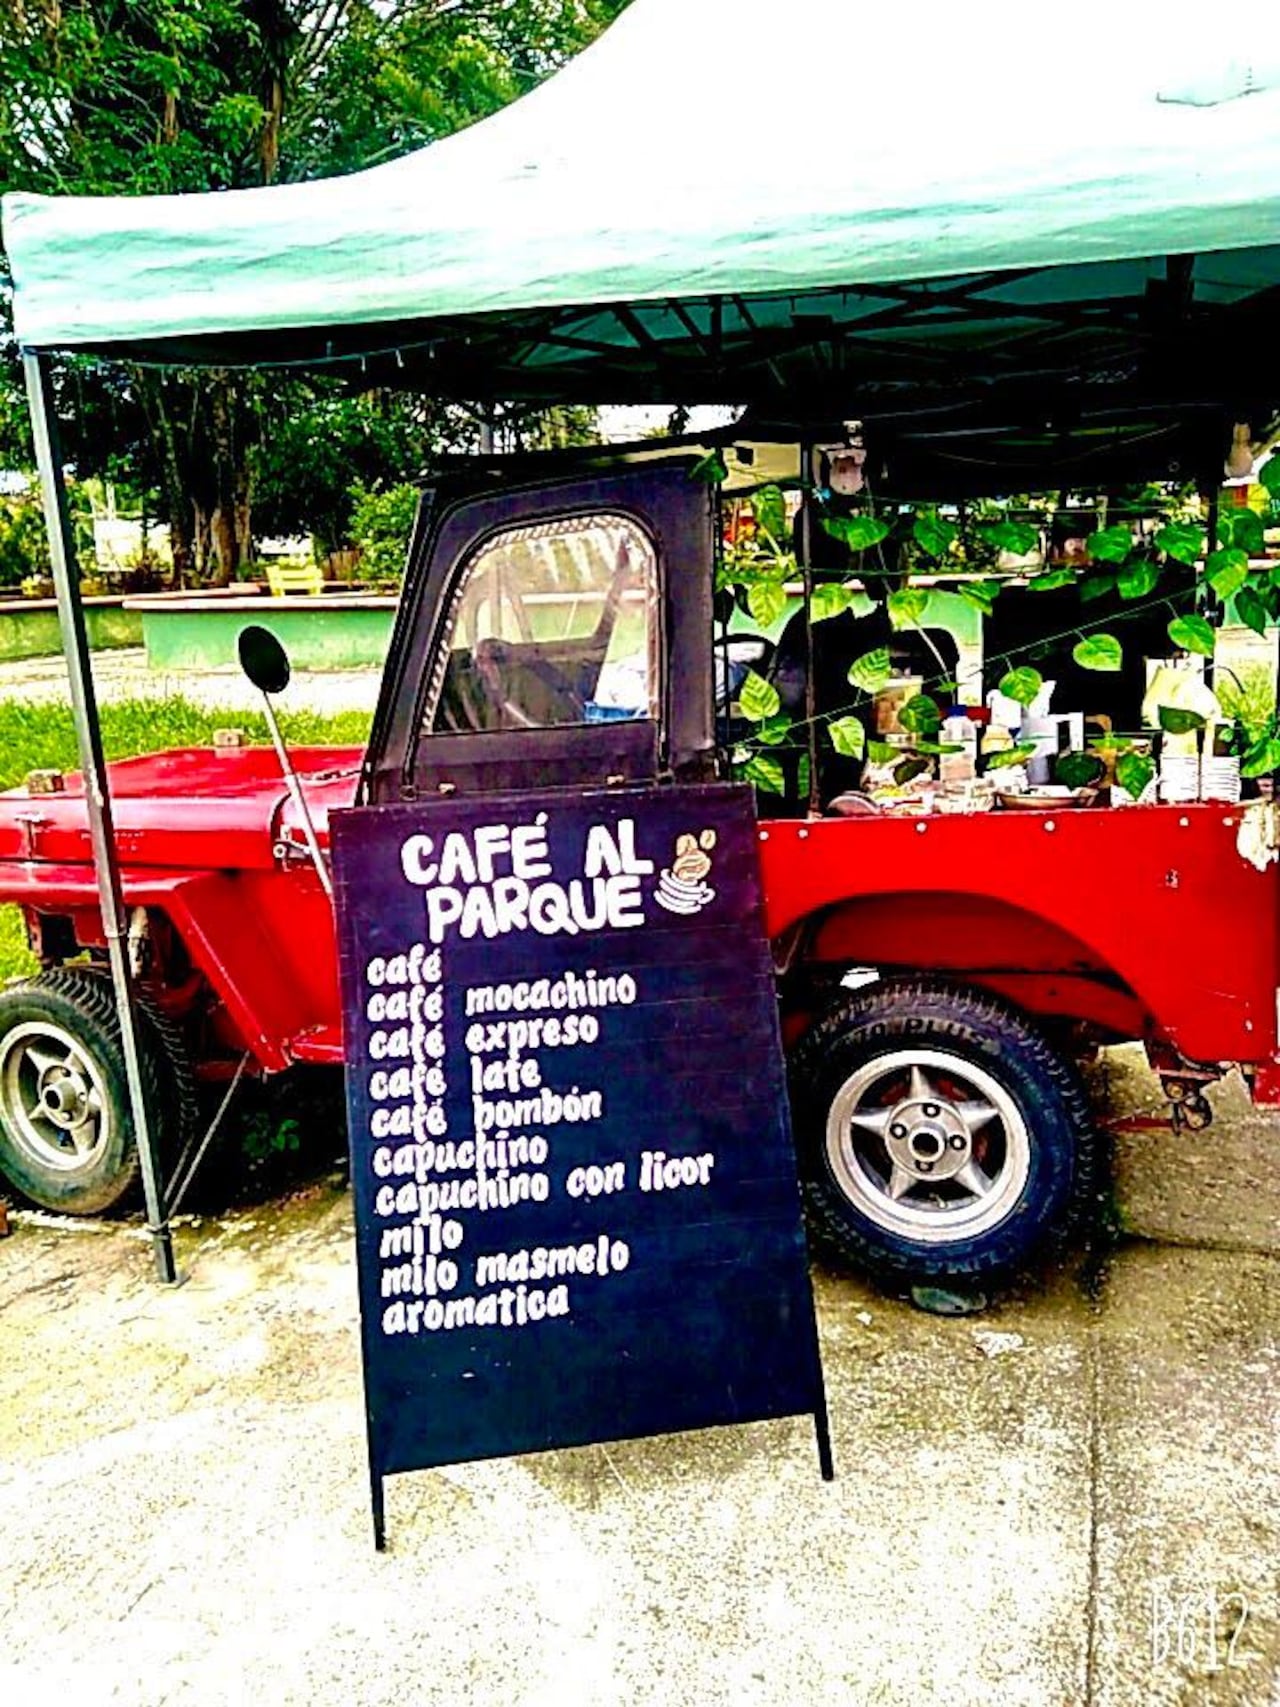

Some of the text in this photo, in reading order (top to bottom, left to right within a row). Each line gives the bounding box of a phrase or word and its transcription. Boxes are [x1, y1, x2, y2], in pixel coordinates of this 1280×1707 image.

[401, 812, 654, 886] CAFÉ AL
[426, 875, 645, 943] PARQUE
[367, 943, 443, 986] café
[367, 969, 637, 1024] café mocachino
[369, 1014, 600, 1064] café expreso
[370, 1055, 542, 1104] café late
[371, 1087, 602, 1144] café bombón
[373, 1130, 548, 1184] capuchino
[375, 1151, 715, 1226] capuchino con licor
[379, 1213, 464, 1258] milo
[381, 1235, 630, 1297] milo masmelo
[382, 1284, 570, 1335] aromatica
